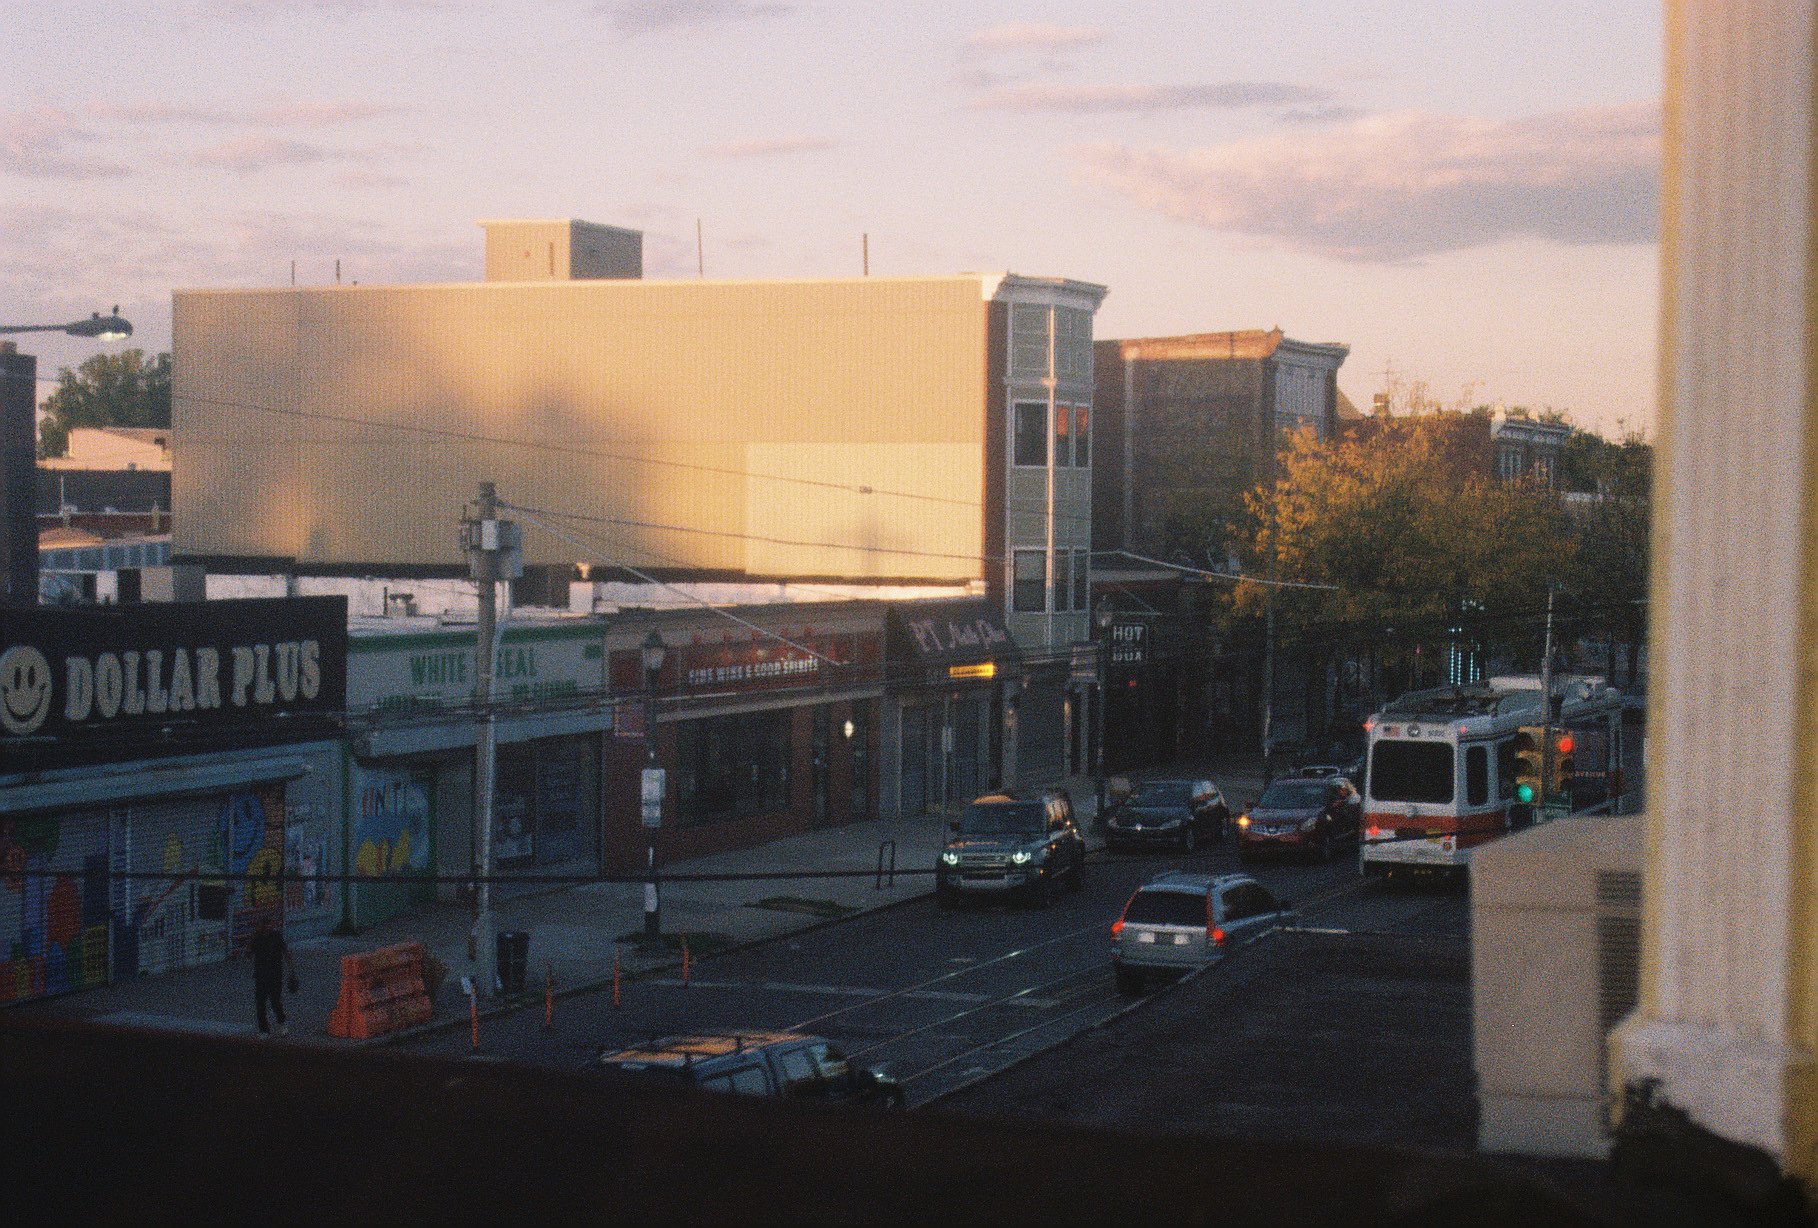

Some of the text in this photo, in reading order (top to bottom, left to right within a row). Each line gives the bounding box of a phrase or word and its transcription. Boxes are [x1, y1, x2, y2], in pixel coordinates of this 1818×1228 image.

[1112, 625, 1144, 641] HOT
[64, 639, 321, 721] DOLLAR PLUS
[410, 652, 467, 686] WHITE
[688, 667, 713, 685] FINE
[716, 665, 743, 682] WINE
